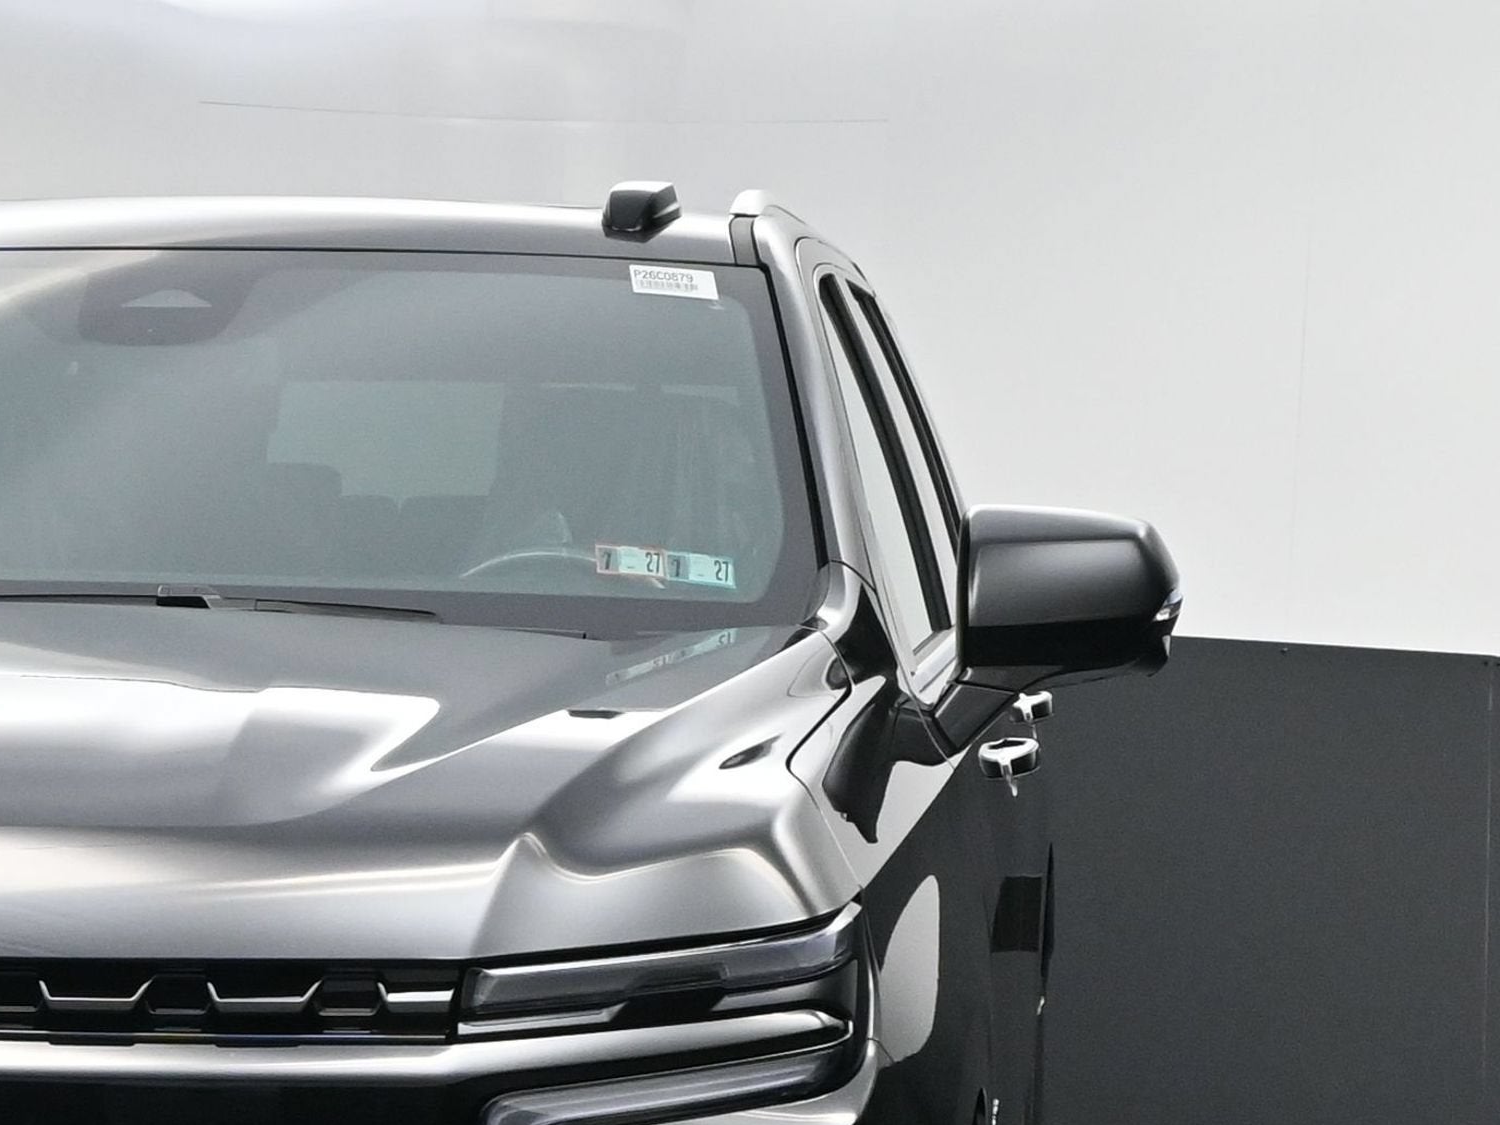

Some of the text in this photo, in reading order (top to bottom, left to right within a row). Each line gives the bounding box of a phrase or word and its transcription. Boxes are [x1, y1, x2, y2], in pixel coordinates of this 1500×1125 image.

[633, 269, 694, 283] P26C0879
[645, 552, 661, 574] 27
[713, 560, 729, 583] 27
